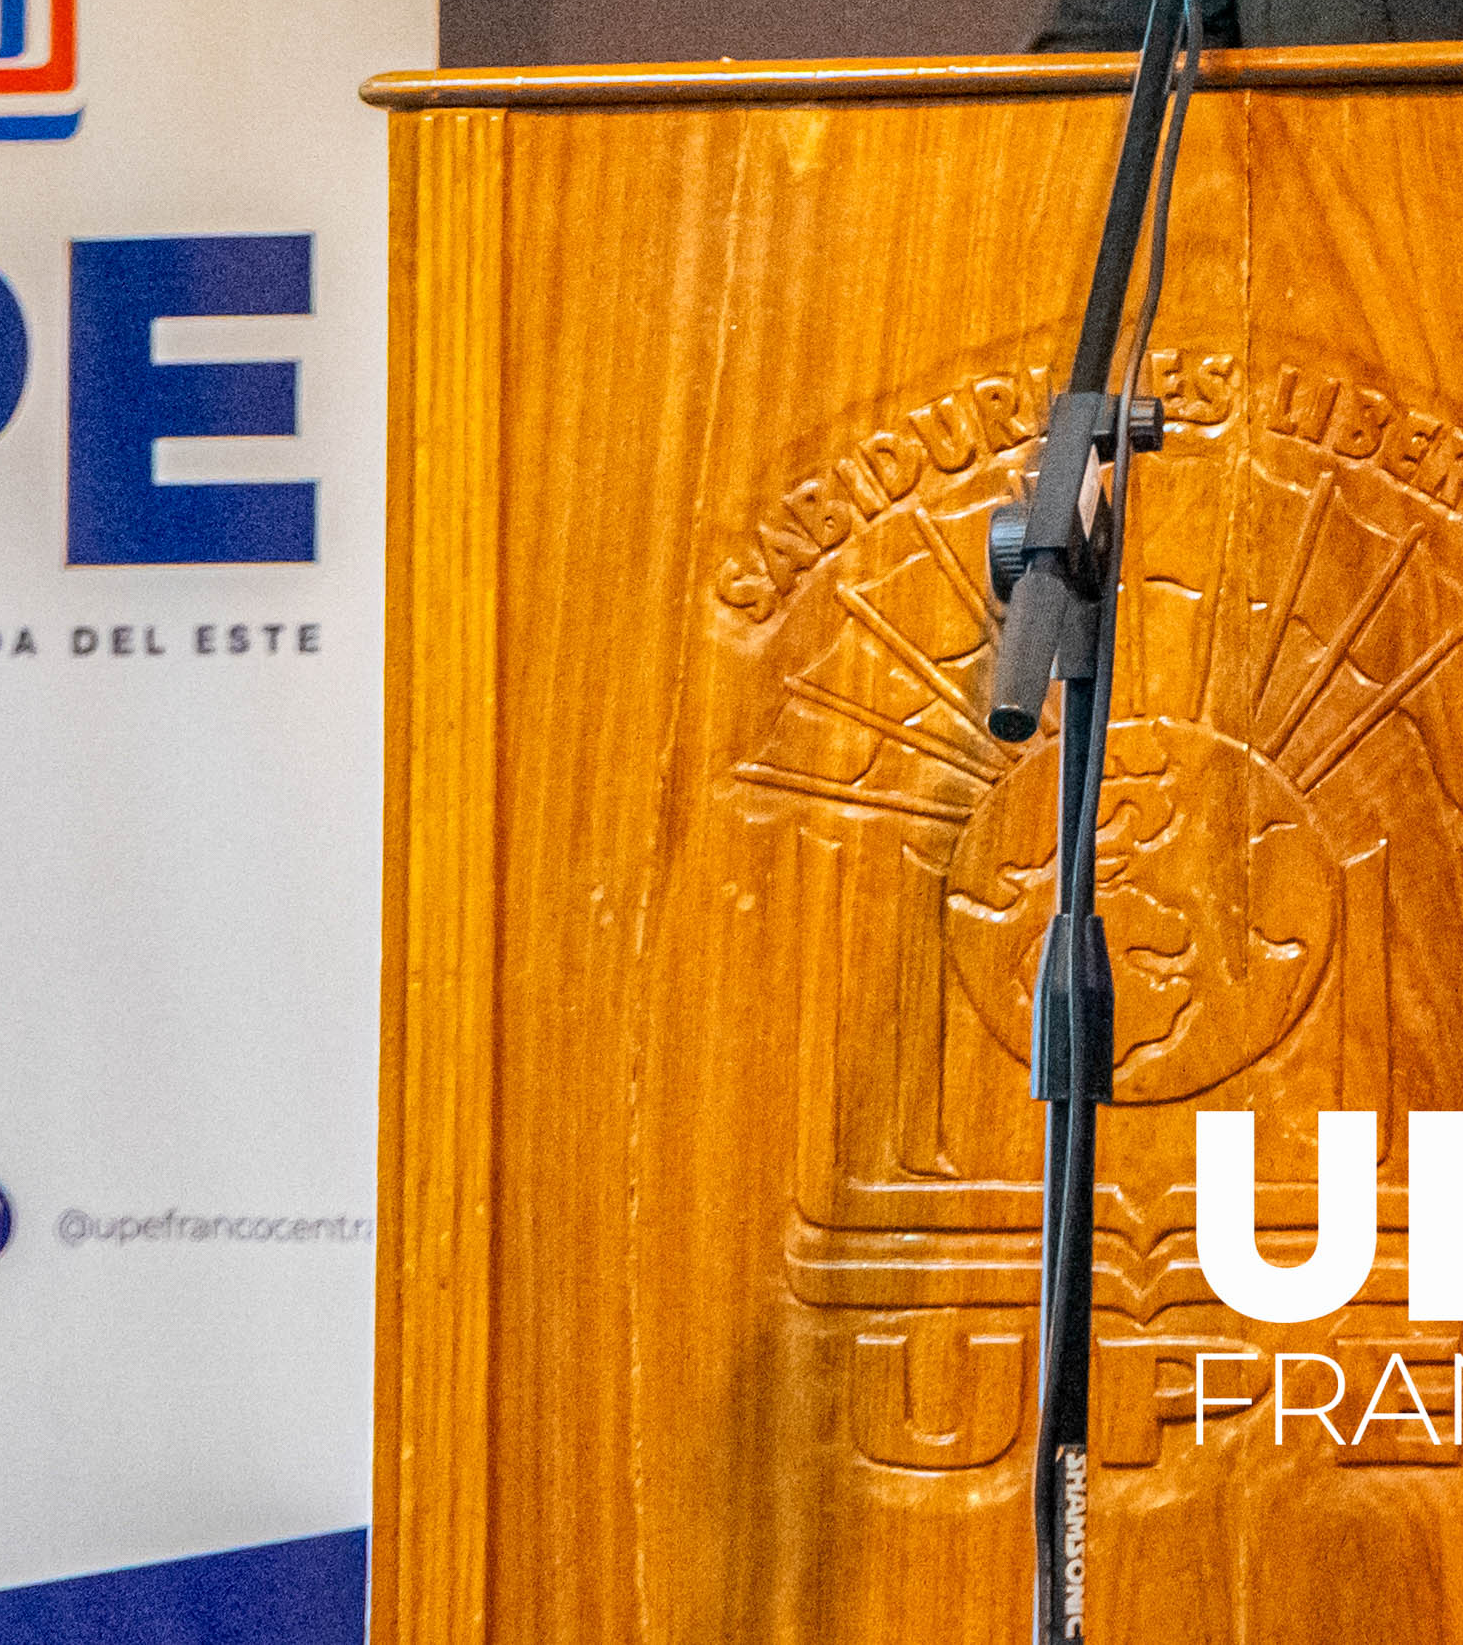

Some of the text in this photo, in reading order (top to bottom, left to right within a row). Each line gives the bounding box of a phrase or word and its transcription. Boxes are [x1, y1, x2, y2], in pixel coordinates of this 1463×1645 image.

[716, 364, 1051, 624] SABIDURI
[71, 624, 166, 658] DEL
[195, 621, 324, 655] ESTE
[1064, 1452, 1087, 1639] SHAMSONIC
